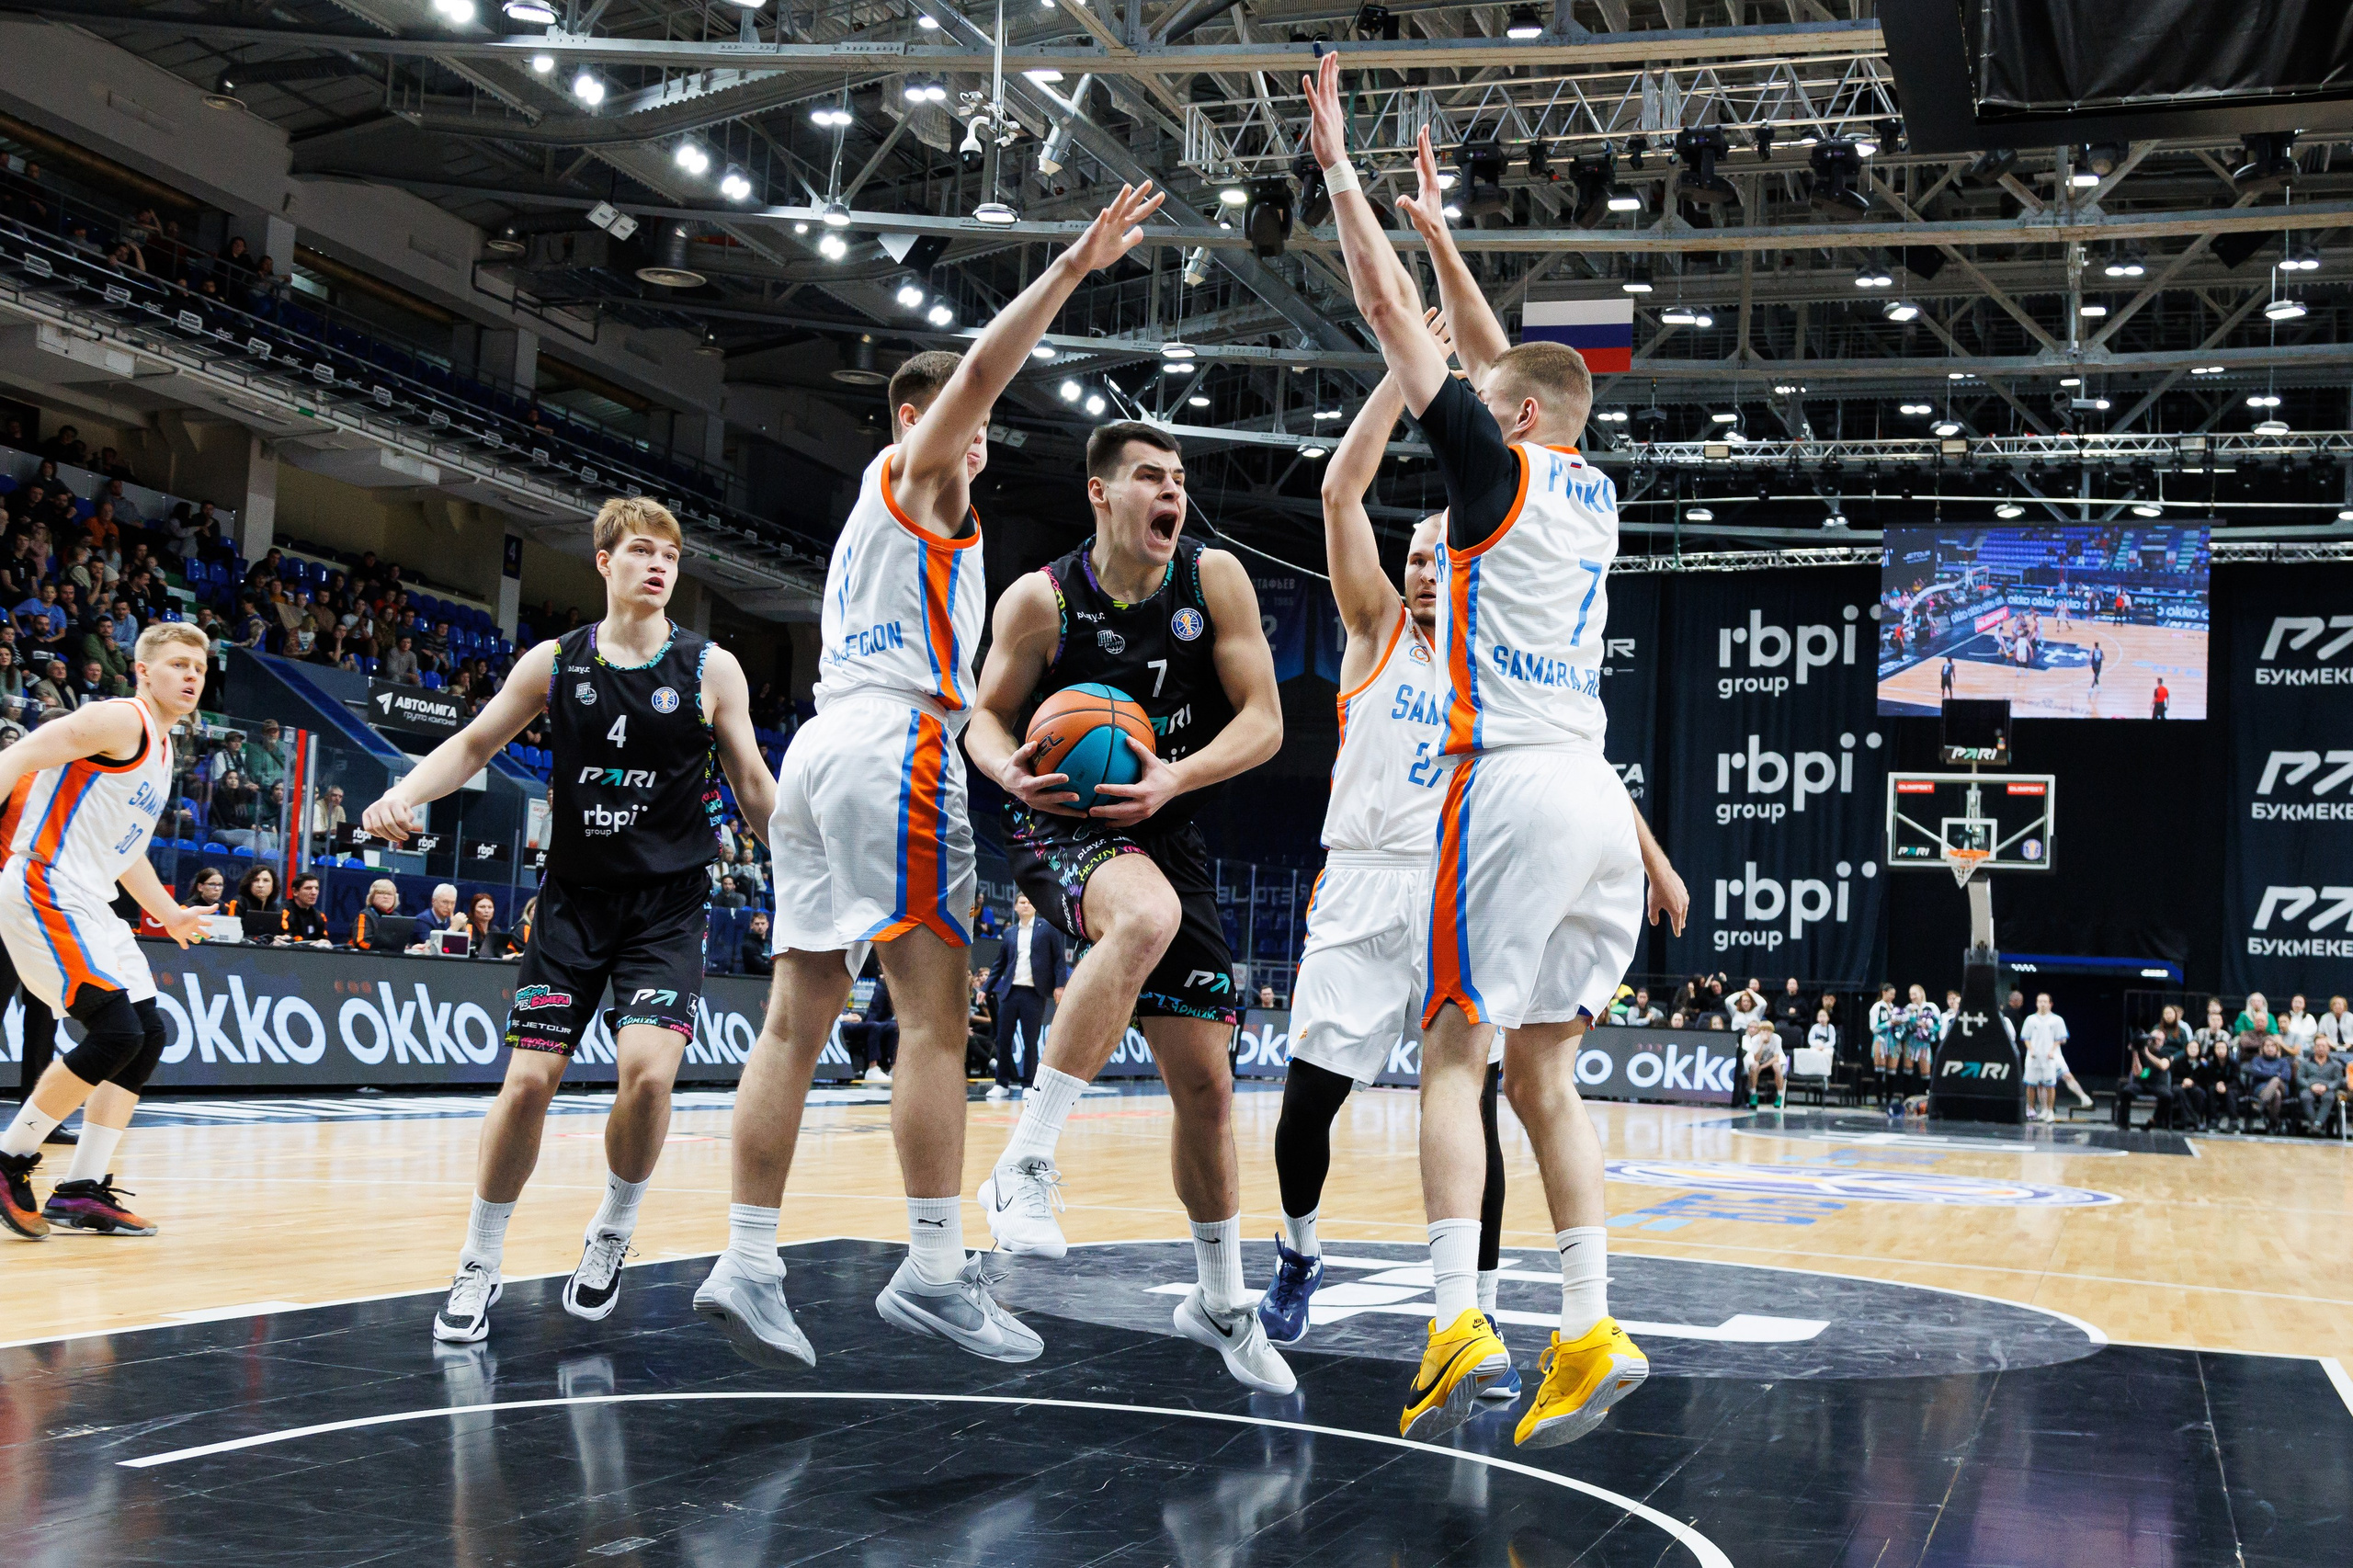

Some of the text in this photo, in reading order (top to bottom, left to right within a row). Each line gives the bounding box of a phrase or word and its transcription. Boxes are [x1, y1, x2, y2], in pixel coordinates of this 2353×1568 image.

[1570, 557, 1602, 647] 7
[841, 620, 904, 658] EGION
[1719, 605, 1881, 685] rbpi
[1147, 659, 1167, 698] 7
[1493, 645, 1581, 690] SAMARA
[2256, 667, 2353, 686] БУКМЕК
[1718, 676, 1789, 699] group
[394, 696, 457, 719] АВТОЛИГА
[607, 714, 627, 748] 4
[1951, 747, 1997, 760] PARI
[578, 767, 656, 789] PARI
[1717, 733, 1881, 812] rbpi
[584, 804, 648, 833] rbpi
[1716, 802, 1786, 824] group
[1714, 861, 1876, 939] rbpi
[1713, 929, 1783, 951] group
[338, 981, 498, 1064] okko
[522, 1021, 572, 1034] JETOUR
[1941, 1060, 2010, 1080] PARI
